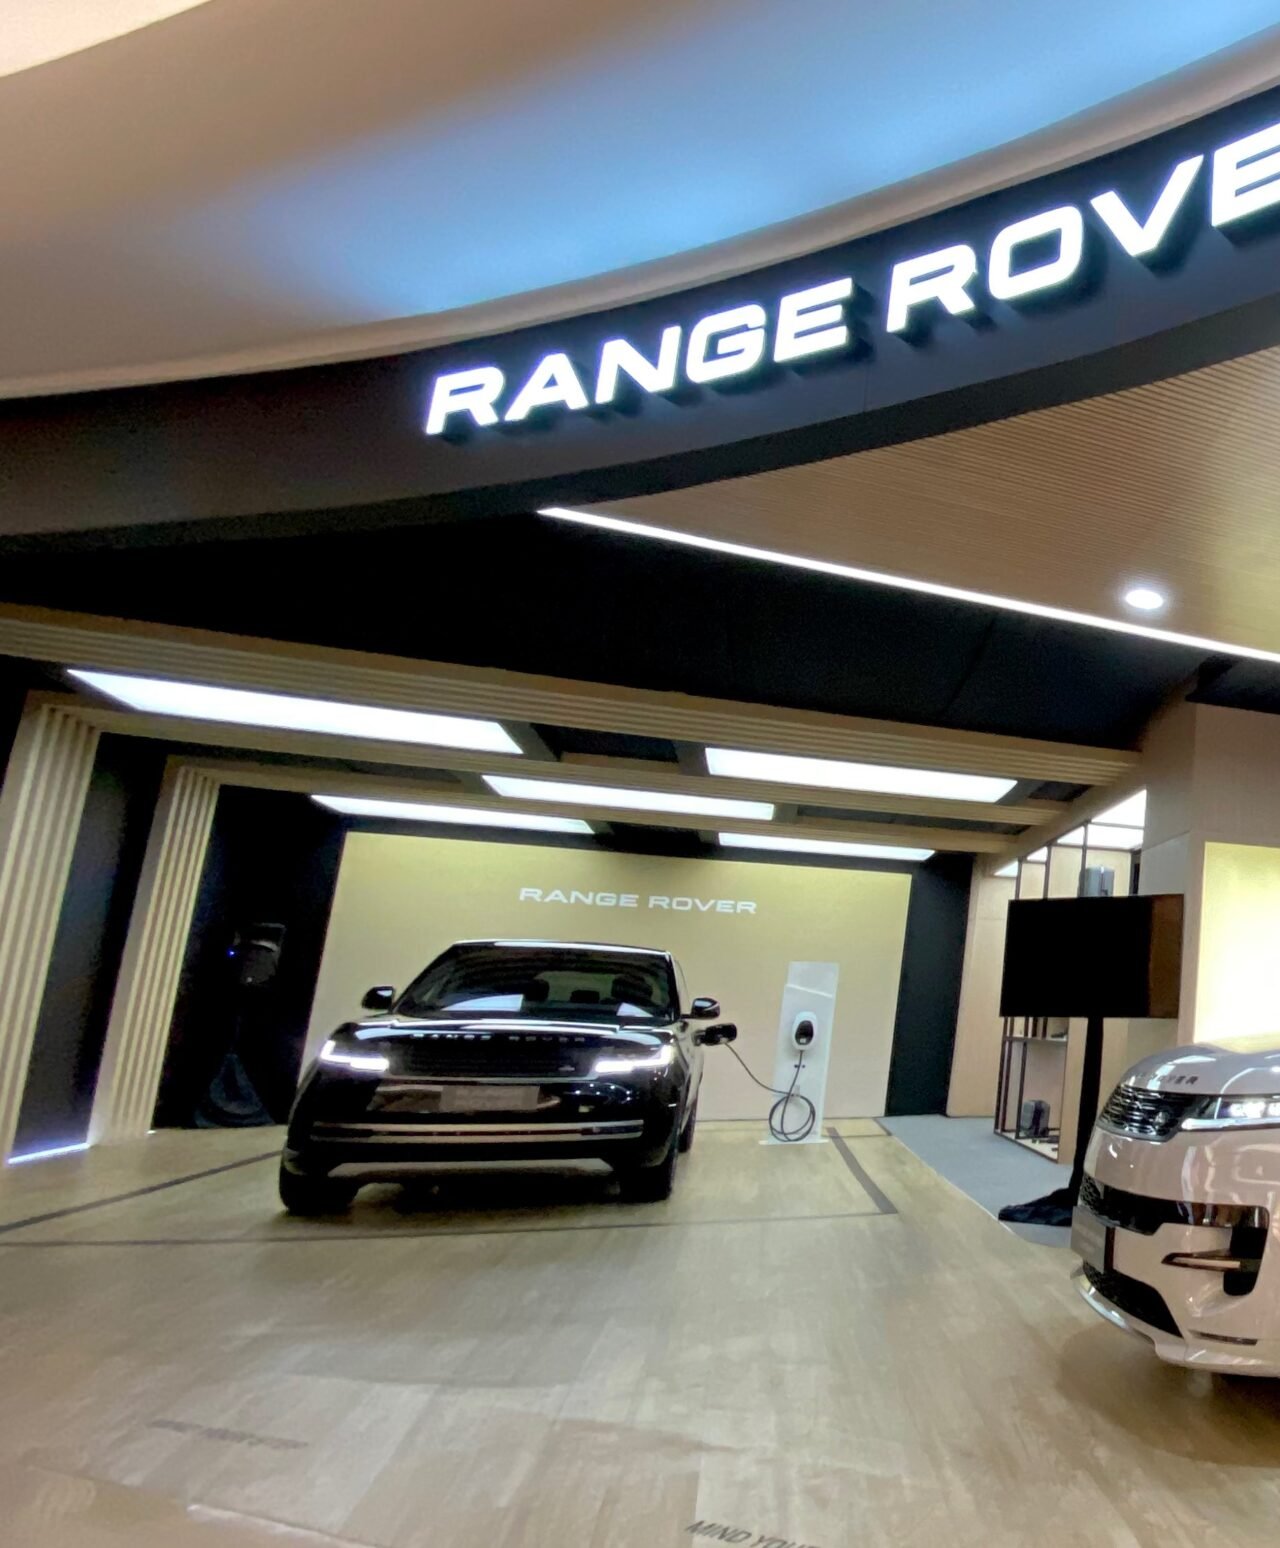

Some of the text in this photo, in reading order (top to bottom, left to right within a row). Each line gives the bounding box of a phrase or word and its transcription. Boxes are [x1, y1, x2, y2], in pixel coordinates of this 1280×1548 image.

[425, 278, 853, 435] RANGE
[518, 887, 757, 914] RANGE ROVER
[684, 1519, 822, 1548] MIND YOU
